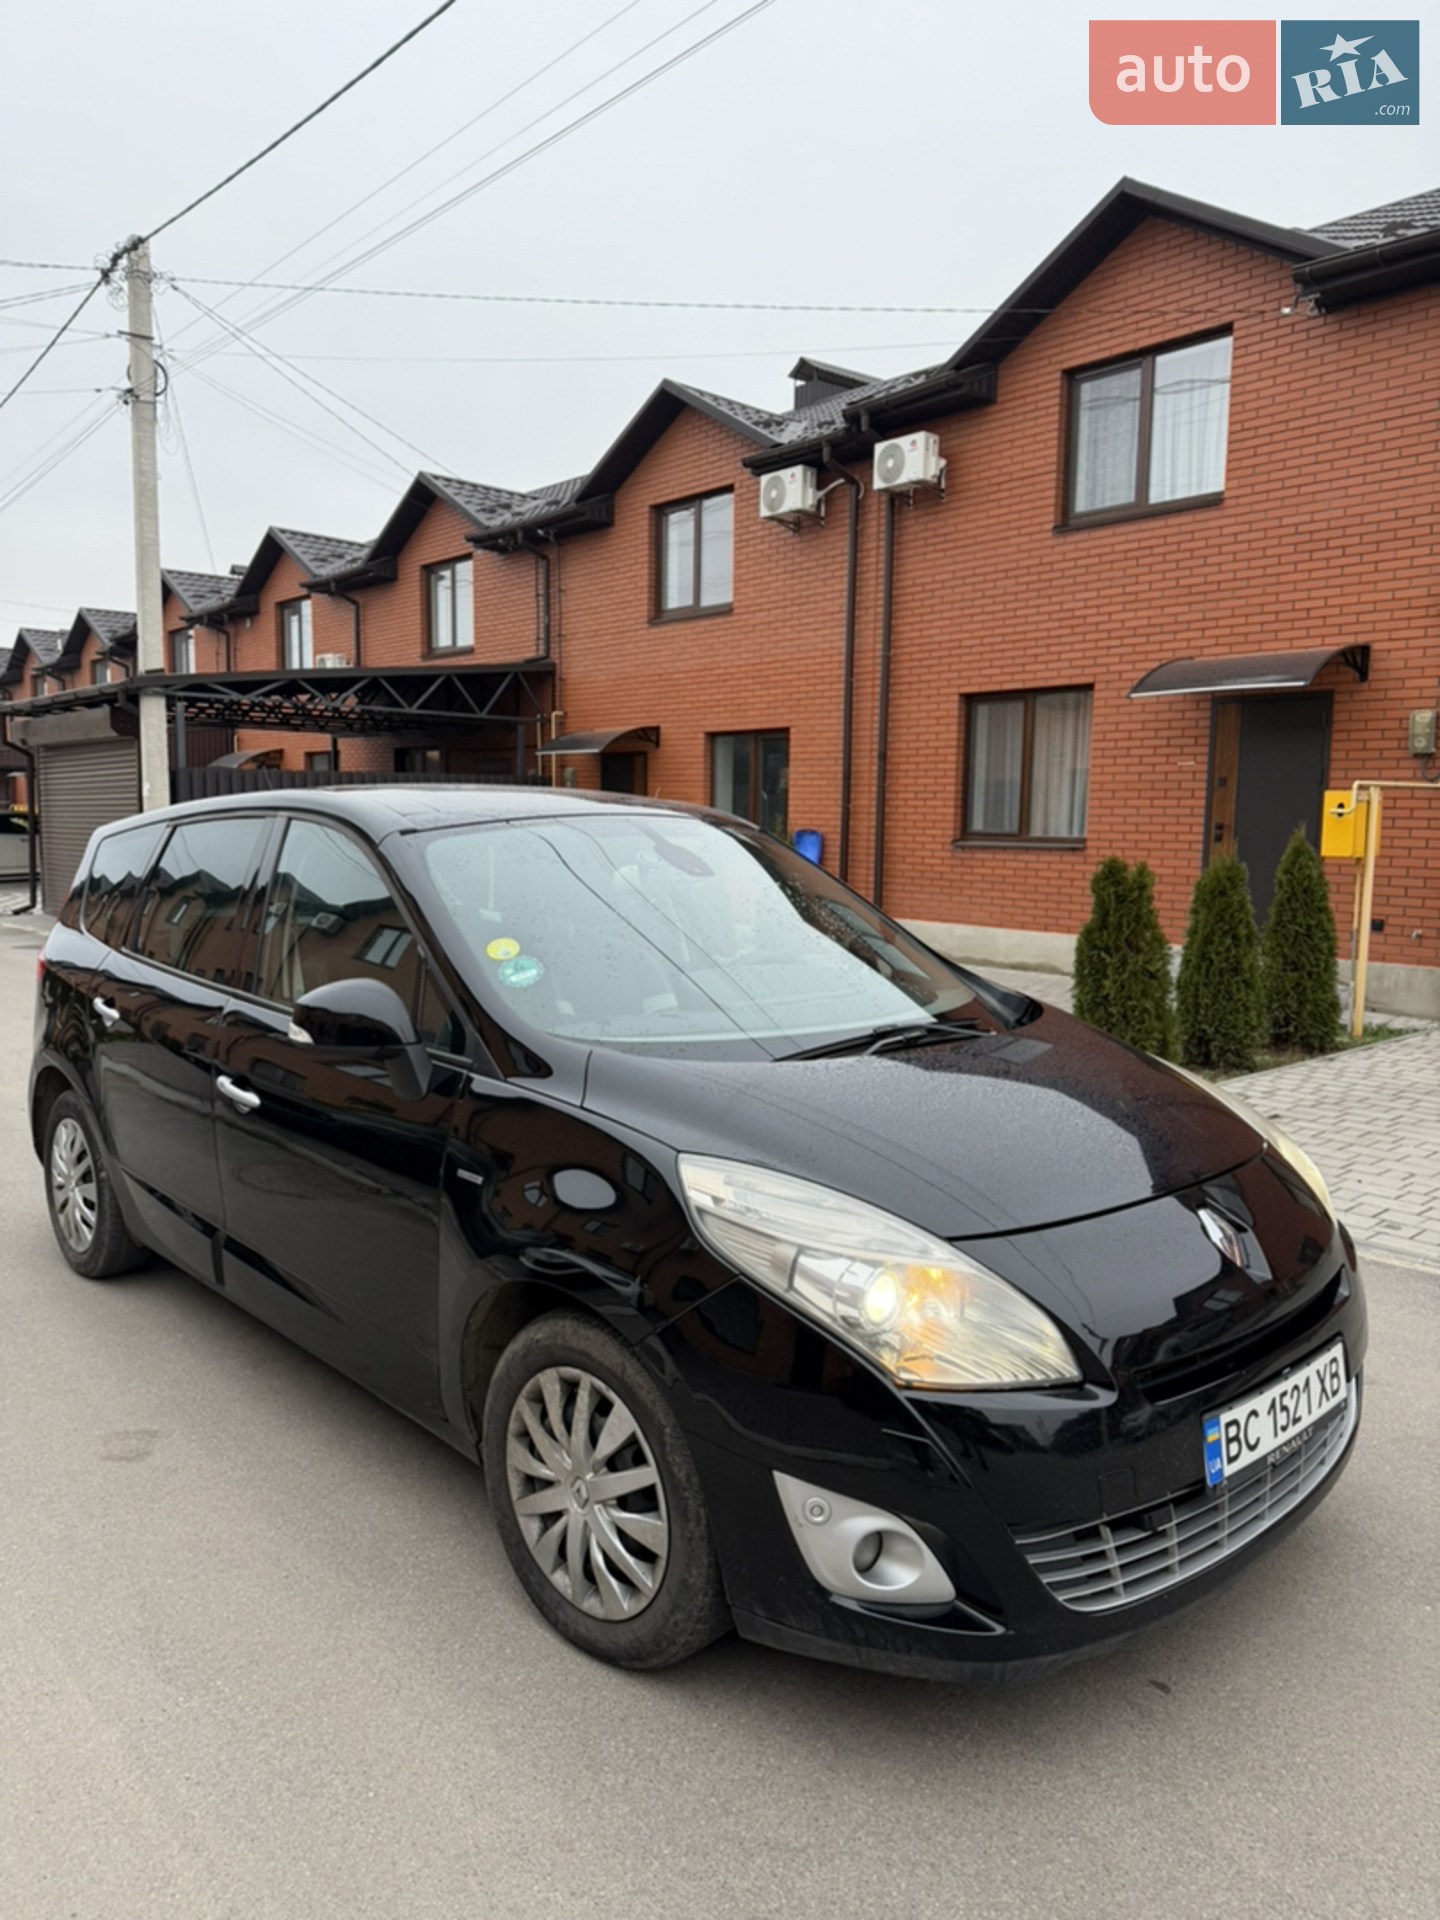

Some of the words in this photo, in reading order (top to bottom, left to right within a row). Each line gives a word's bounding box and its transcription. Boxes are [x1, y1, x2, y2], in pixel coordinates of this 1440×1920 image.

[1224, 1409, 1261, 1466] BC
[1266, 1375, 1312, 1439] 1521
[1315, 1355, 1342, 1409] XB
[1208, 1456, 1223, 1474] UA
